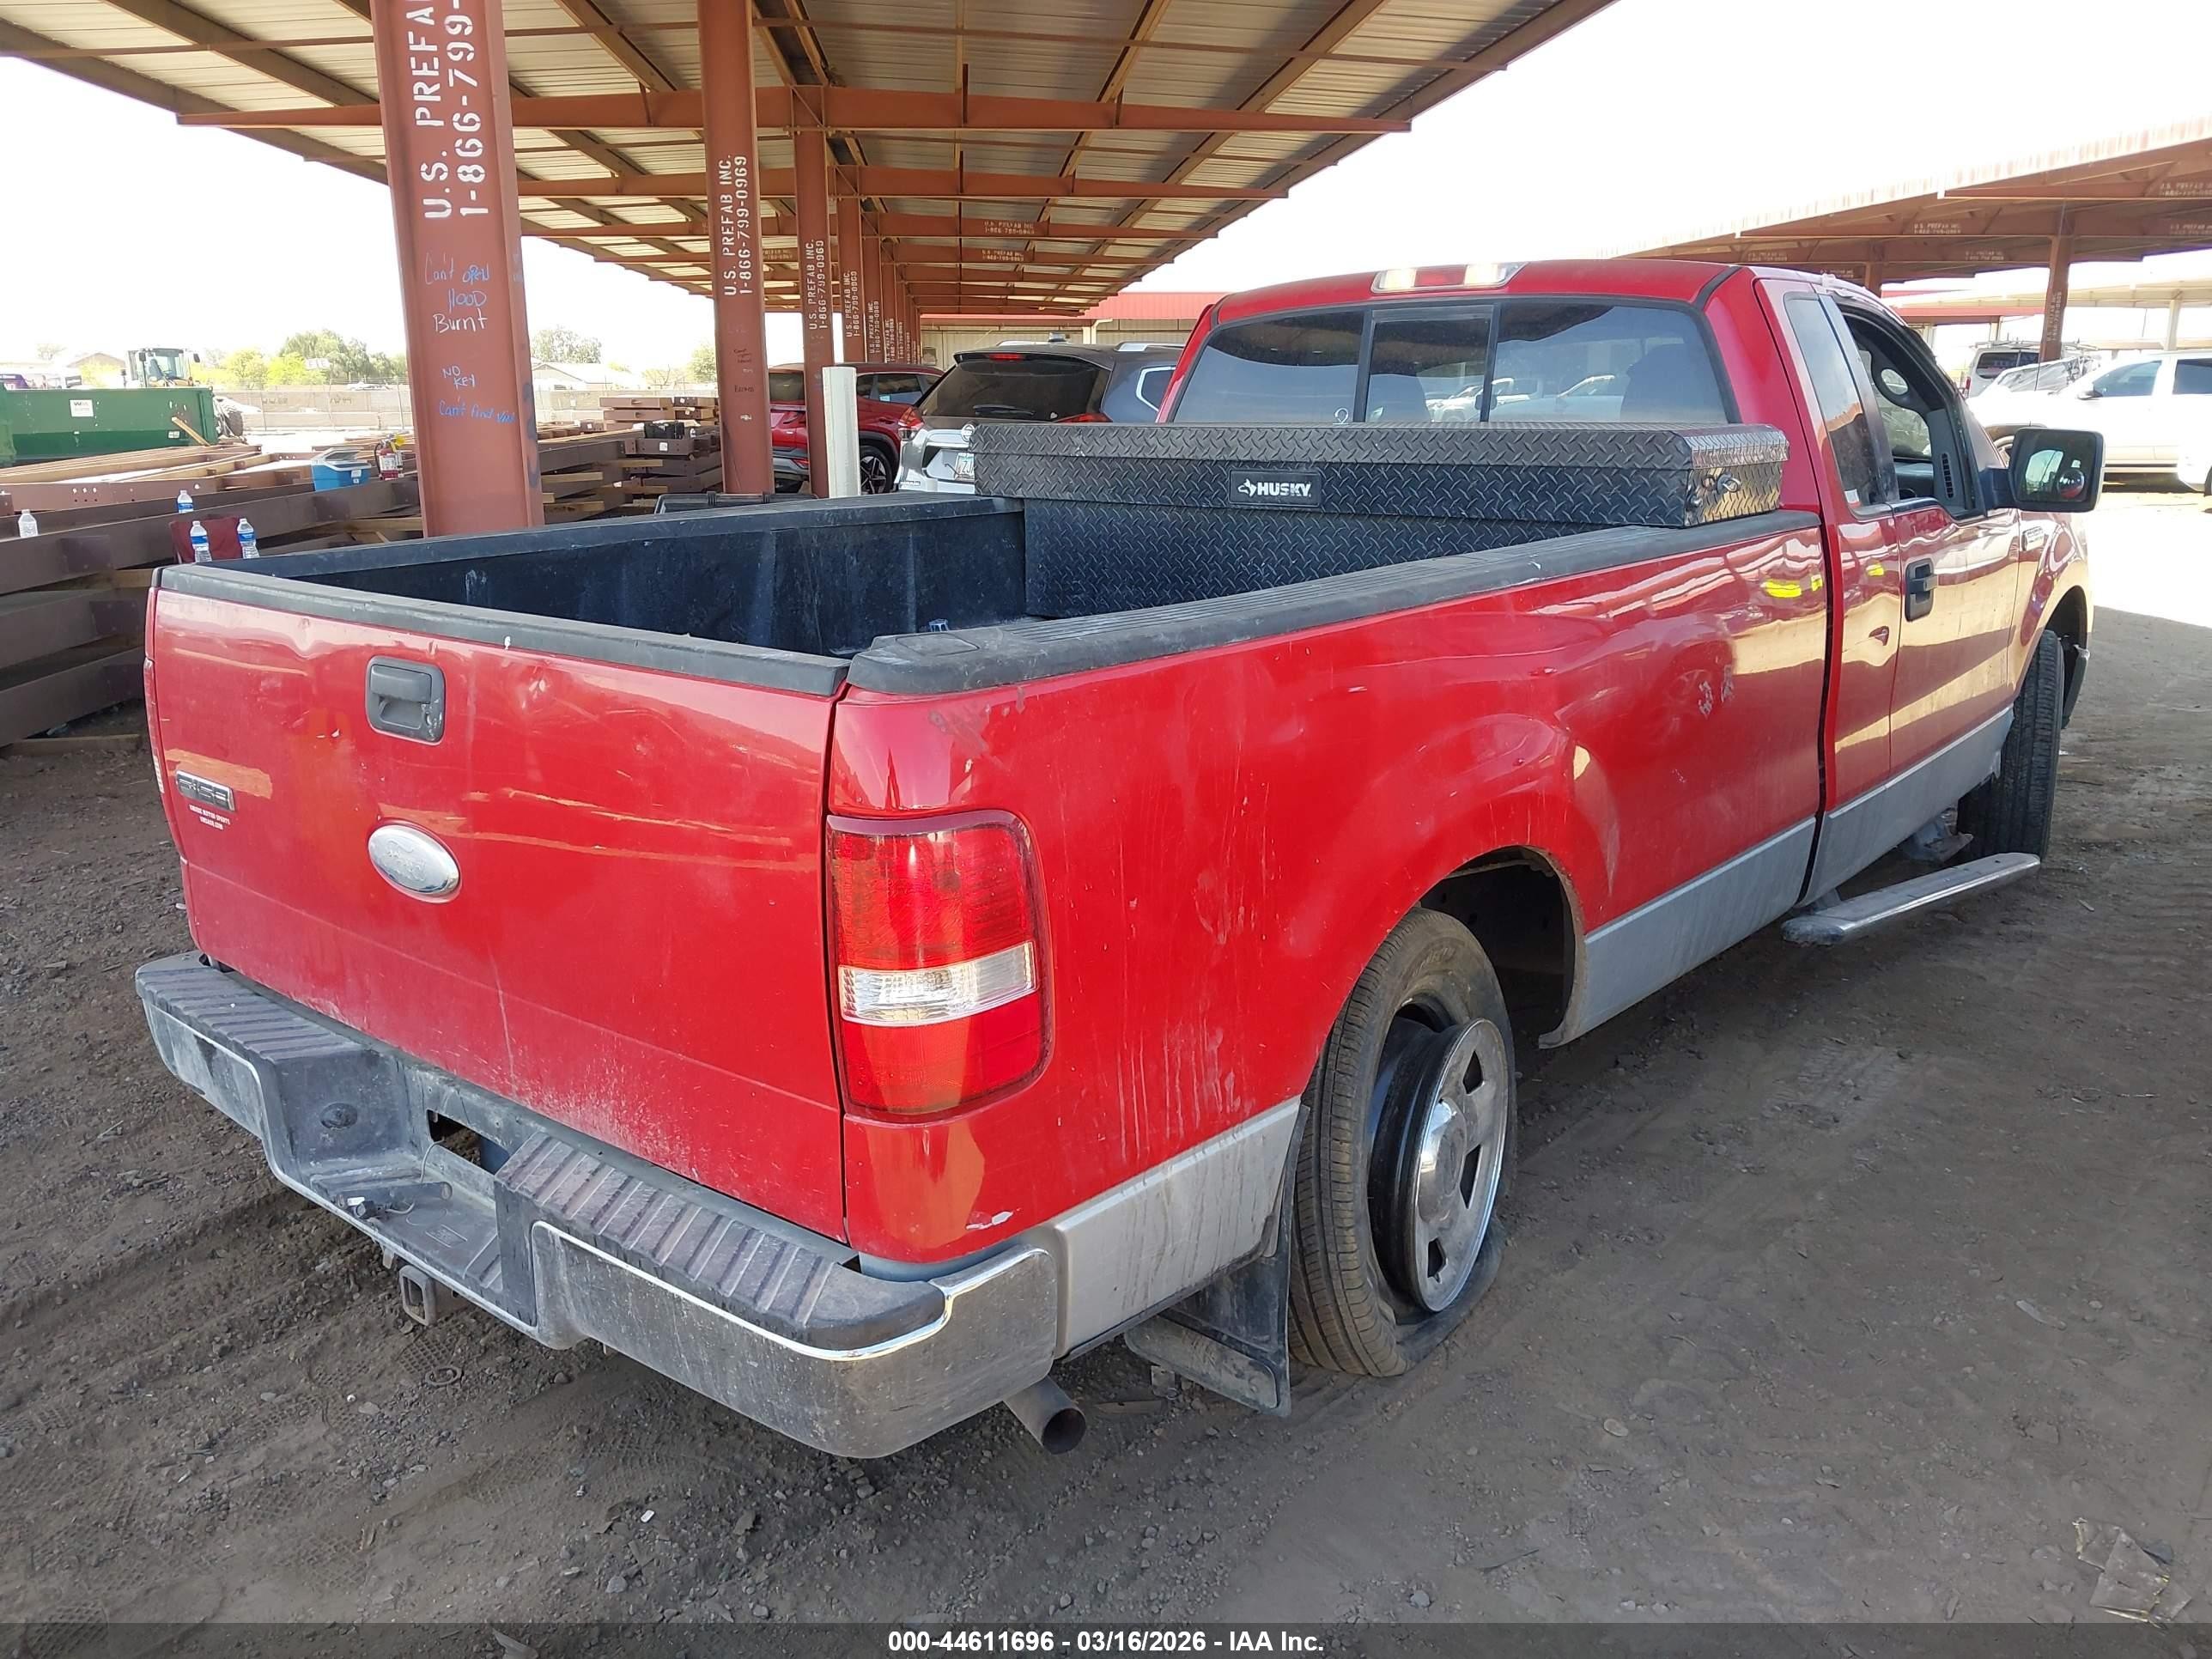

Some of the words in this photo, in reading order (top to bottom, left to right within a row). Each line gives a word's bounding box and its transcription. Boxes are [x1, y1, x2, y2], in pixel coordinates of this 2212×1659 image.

[405, 0, 445, 126] PREFA
[420, 150, 453, 218] U.S.
[718, 155, 732, 185] INC.
[720, 194, 736, 257] PREFAB
[734, 155, 753, 295] 1-866-799-0969
[805, 239, 816, 259] INC.
[723, 265, 737, 296] U.S.
[806, 264, 817, 305] PREFAB
[843, 289, 853, 319] PREFAB
[432, 307, 489, 334] Burnt
[442, 365, 461, 379] NO
[453, 374, 476, 390] KEY
